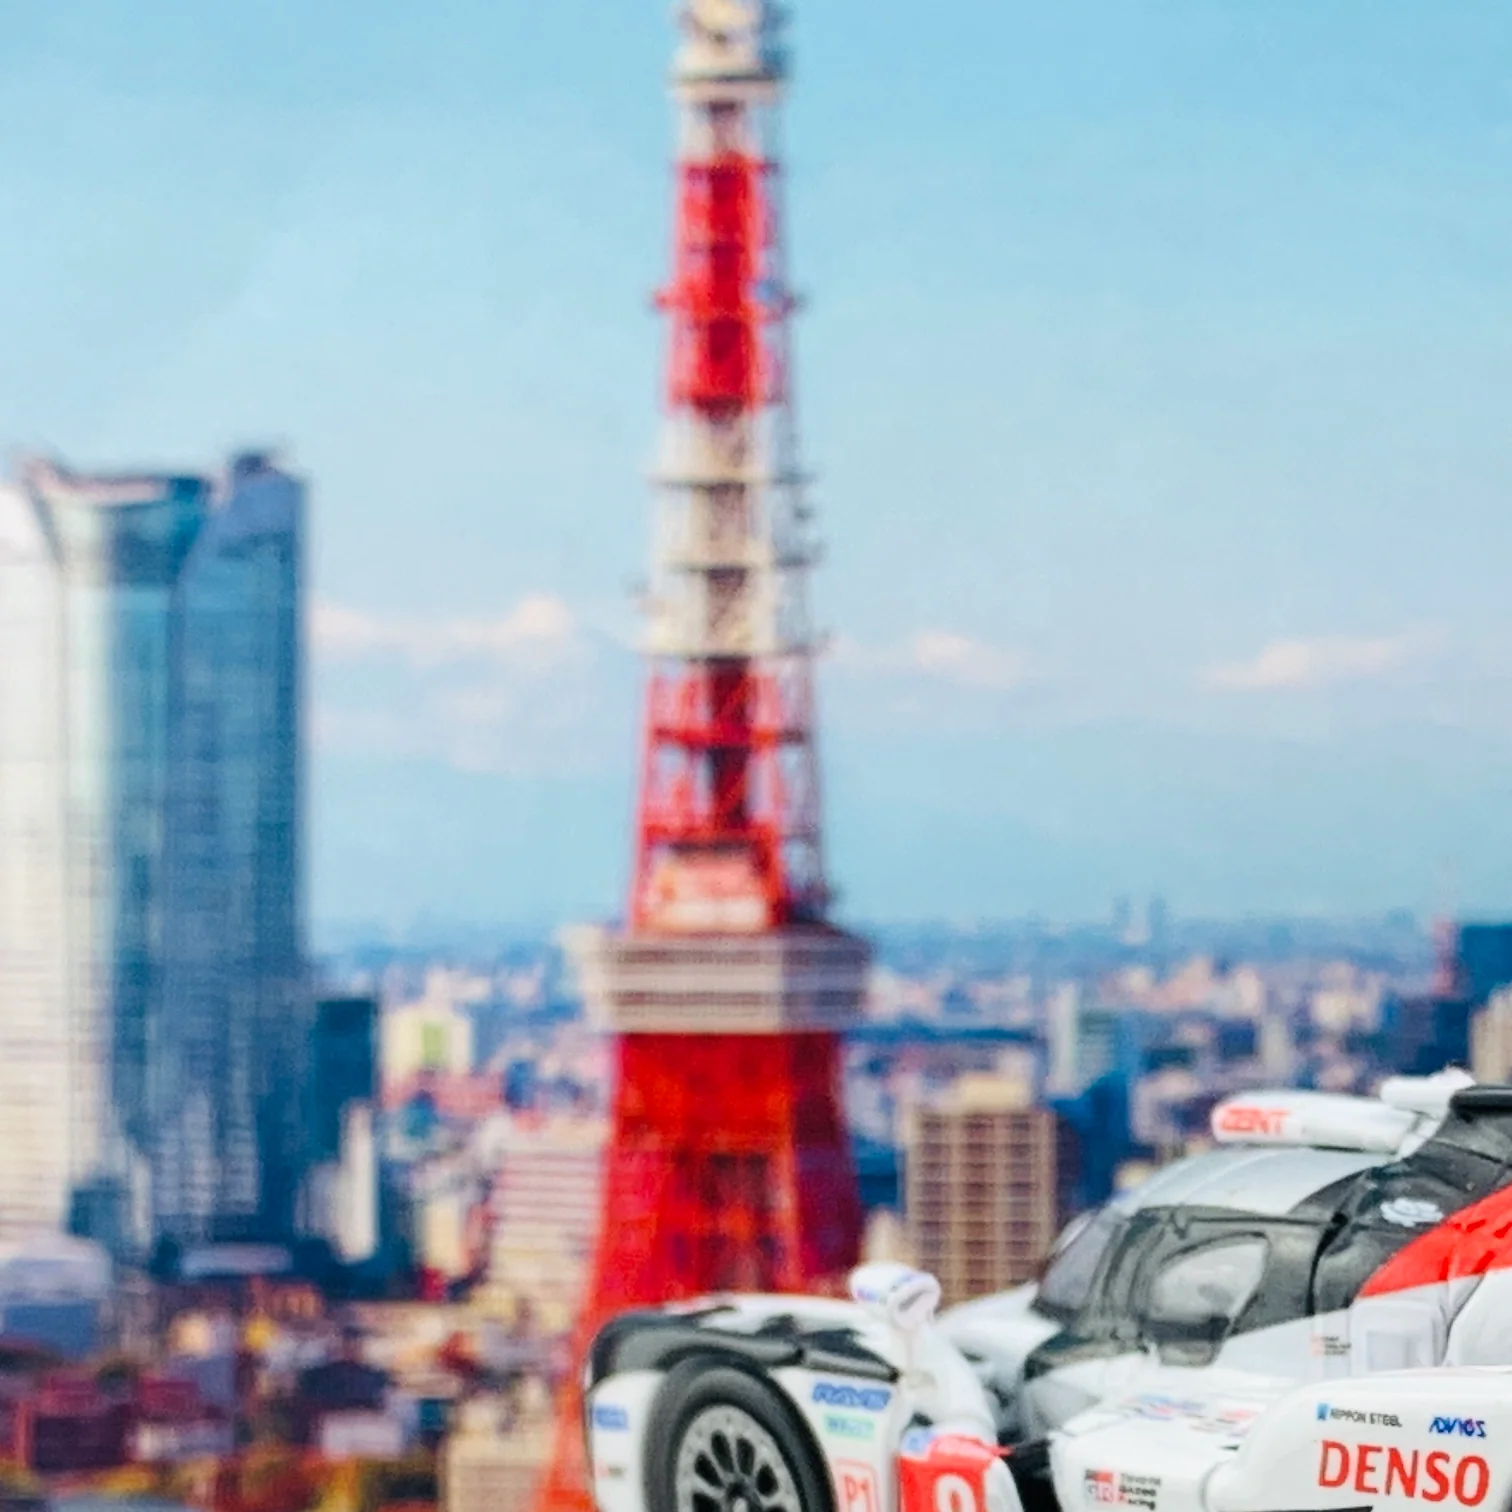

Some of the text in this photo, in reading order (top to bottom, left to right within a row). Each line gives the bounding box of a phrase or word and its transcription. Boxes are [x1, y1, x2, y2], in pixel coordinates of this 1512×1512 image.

[1330, 1408, 1402, 1428] NIPPON STEEL
[1318, 1439, 1491, 1507] DENSO
